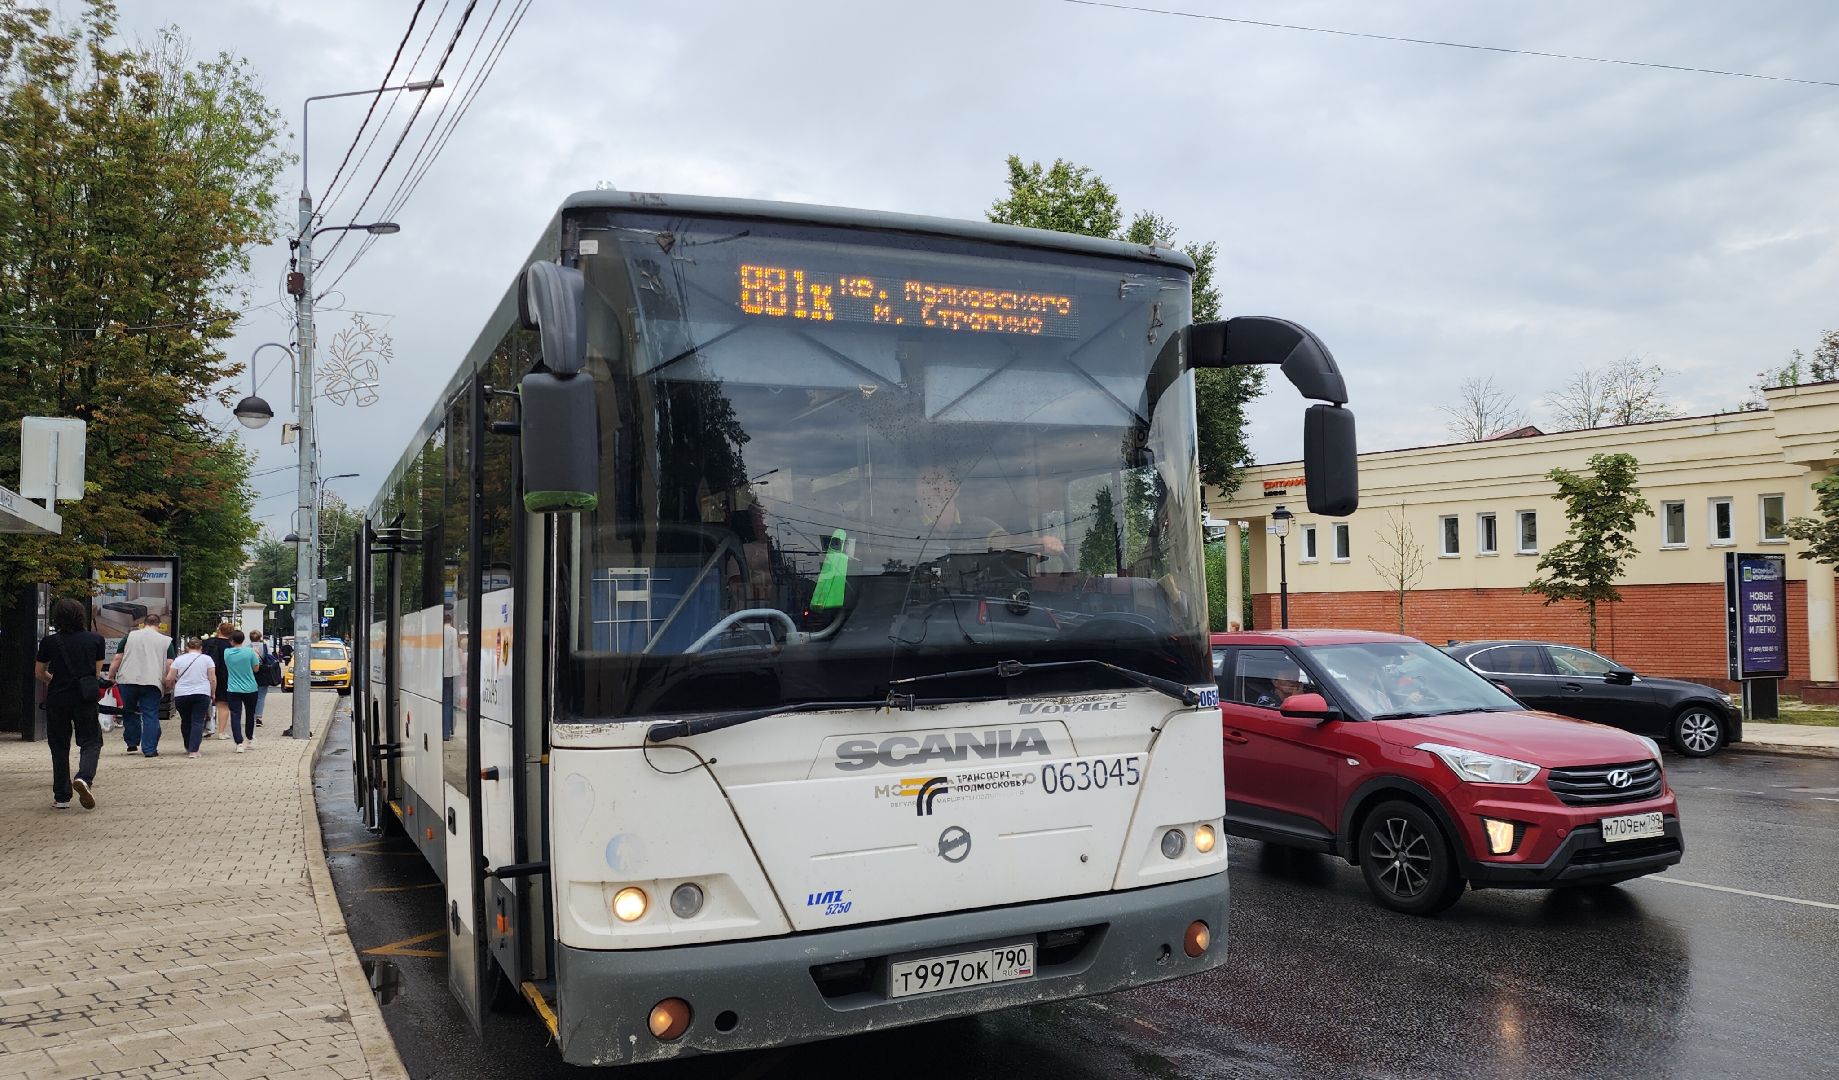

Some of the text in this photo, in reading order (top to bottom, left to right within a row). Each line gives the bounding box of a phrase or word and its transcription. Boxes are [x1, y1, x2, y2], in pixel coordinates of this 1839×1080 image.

[740, 265, 833, 321] 881к
[1749, 591, 1774, 601] НОВЫЕ
[1752, 603, 1772, 612] ОКНА
[1748, 614, 1776, 623] БЫСТРО
[1749, 625, 1777, 635] И ЛЕГКО
[1018, 701, 1128, 716] VOYAGE
[834, 727, 1051, 772] SCANIA
[957, 770, 1011, 783] ТРАНСПОРТ
[1042, 756, 1141, 795] 063045
[957, 779, 1027, 793] ПОДМОСКОВЬЯ
[825, 901, 852, 915] 5250
[901, 948, 1027, 992] Т997ОК 790
[1003, 969, 1018, 977] RUS
